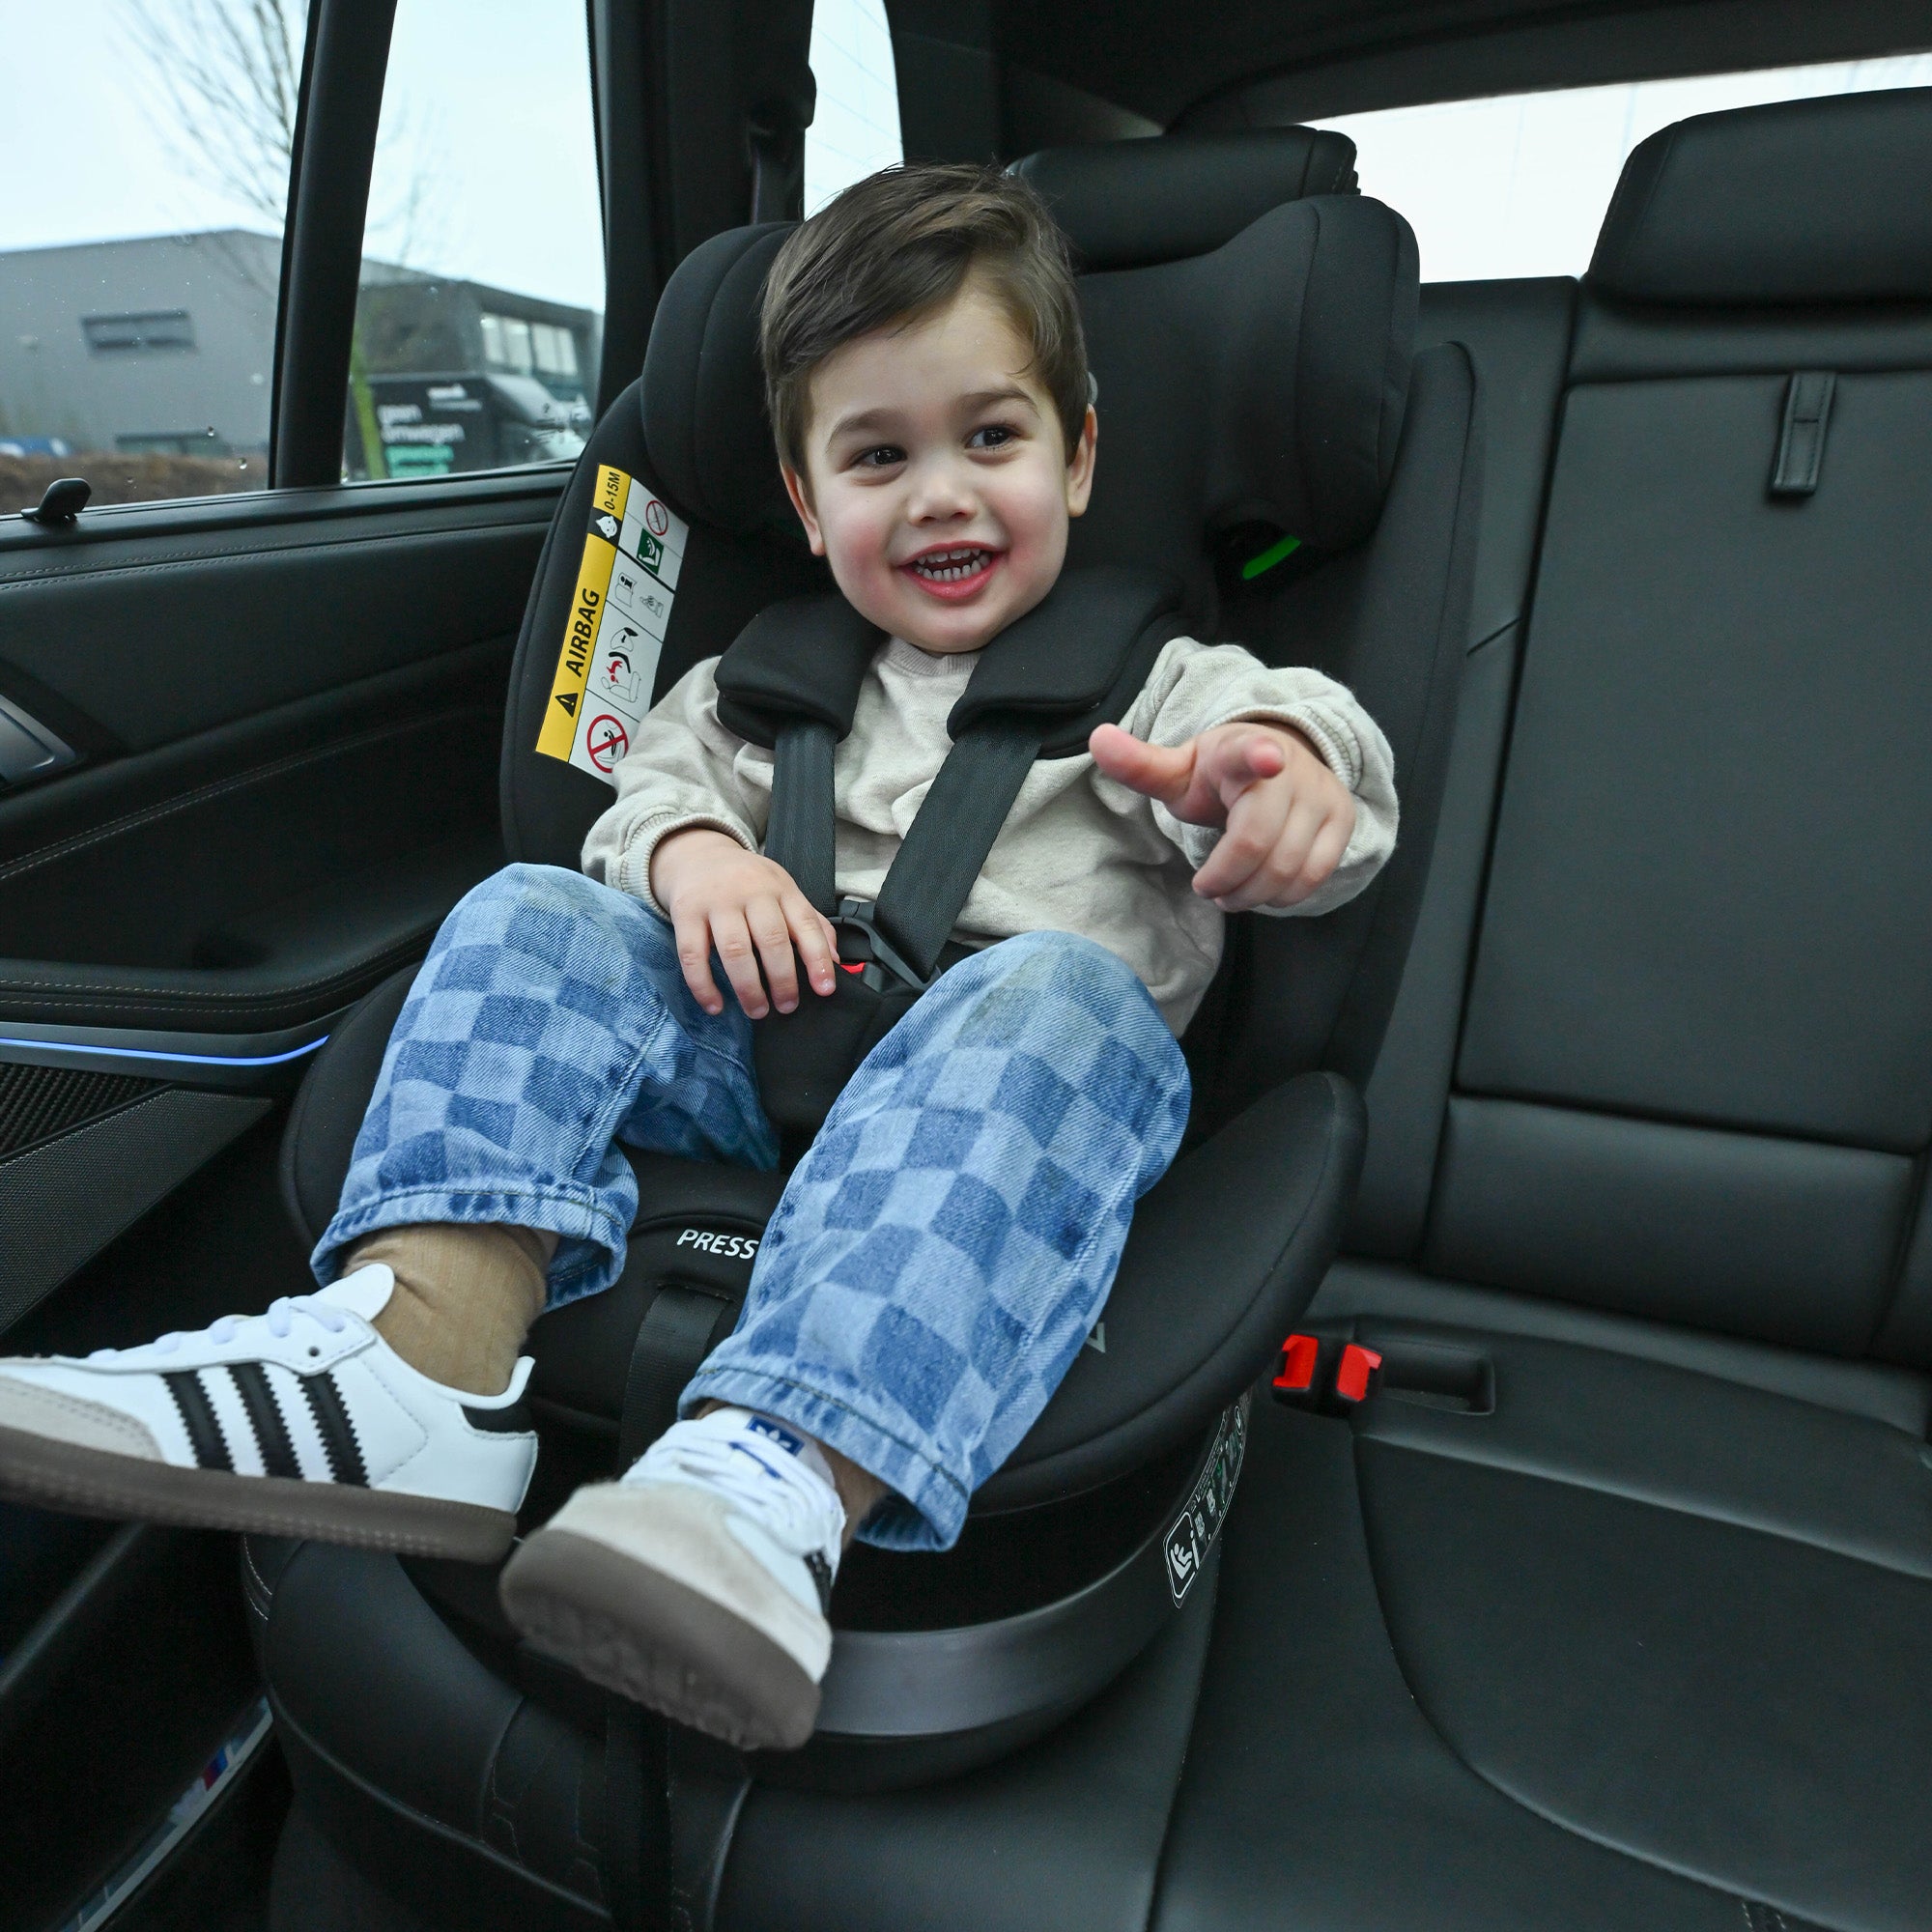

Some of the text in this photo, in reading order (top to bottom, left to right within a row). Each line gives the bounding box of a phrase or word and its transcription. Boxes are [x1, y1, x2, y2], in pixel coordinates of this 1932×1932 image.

[604, 471, 621, 510] 0-15M
[566, 588, 600, 678] AIRBAG
[676, 1229, 759, 1260] PRESS
